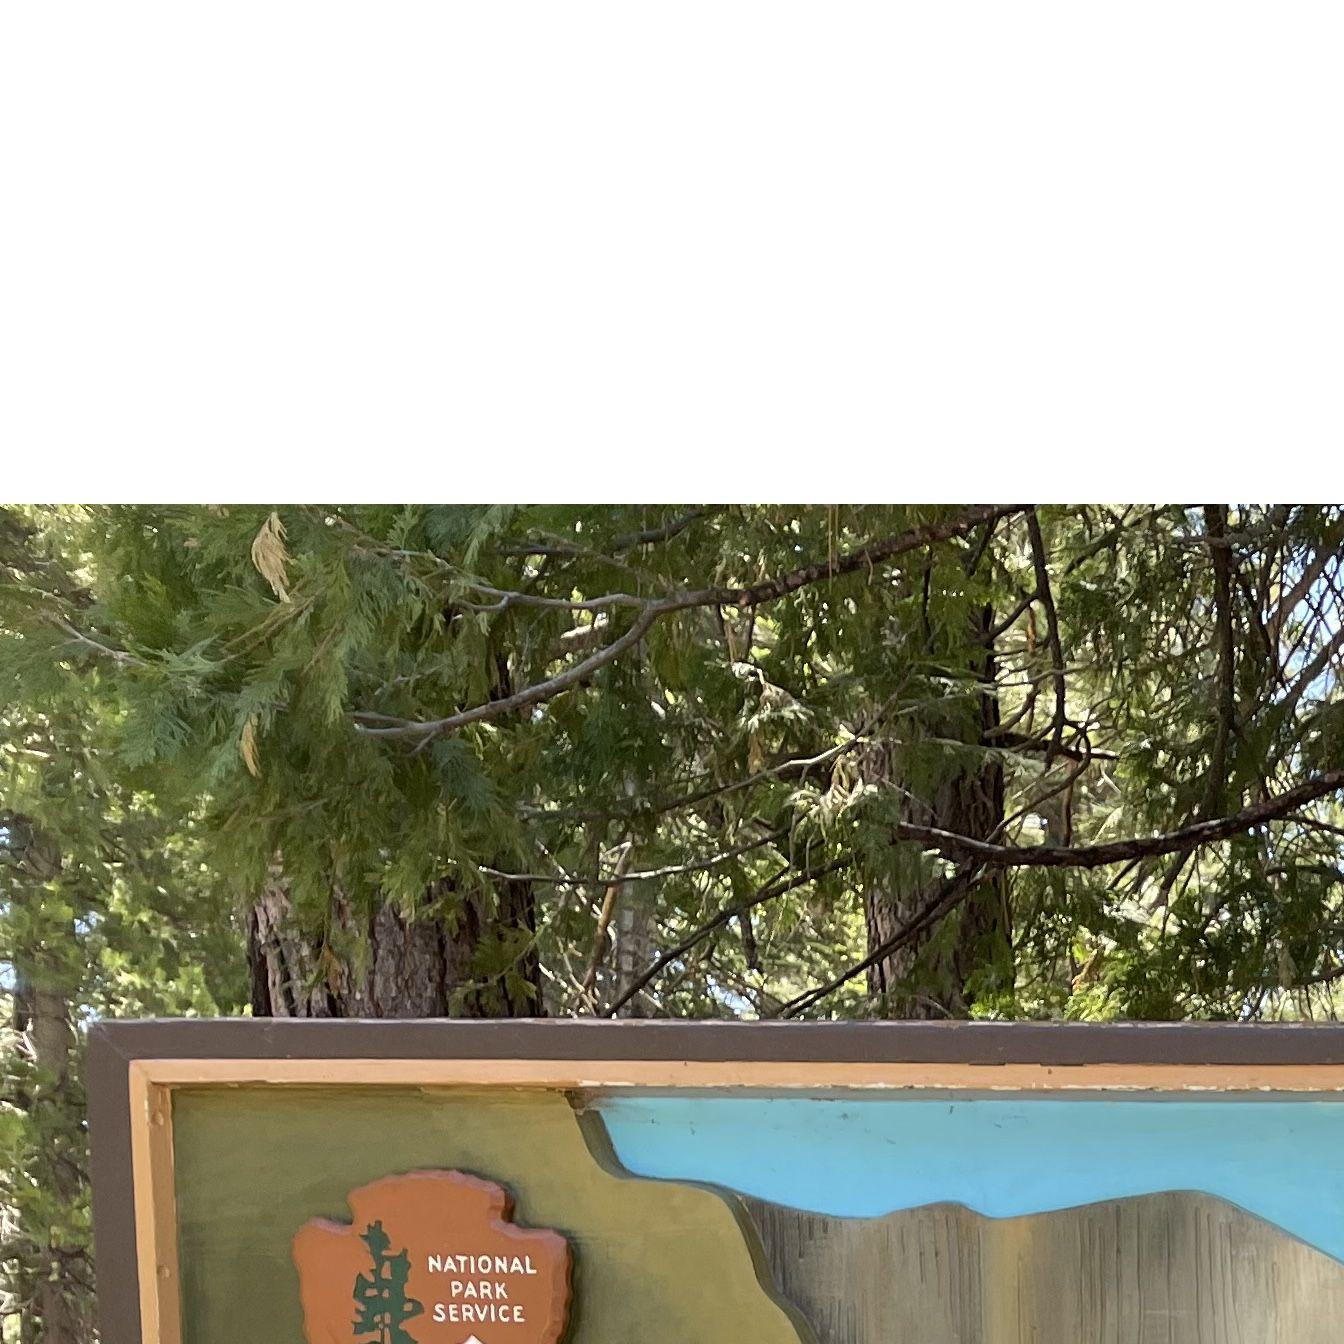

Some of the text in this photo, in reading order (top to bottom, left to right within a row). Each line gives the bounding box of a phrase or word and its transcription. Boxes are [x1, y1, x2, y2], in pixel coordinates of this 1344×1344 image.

[427, 1254, 537, 1276] NATIONAL
[450, 1280, 508, 1300] PARK
[432, 1303, 525, 1323] SERVICE
